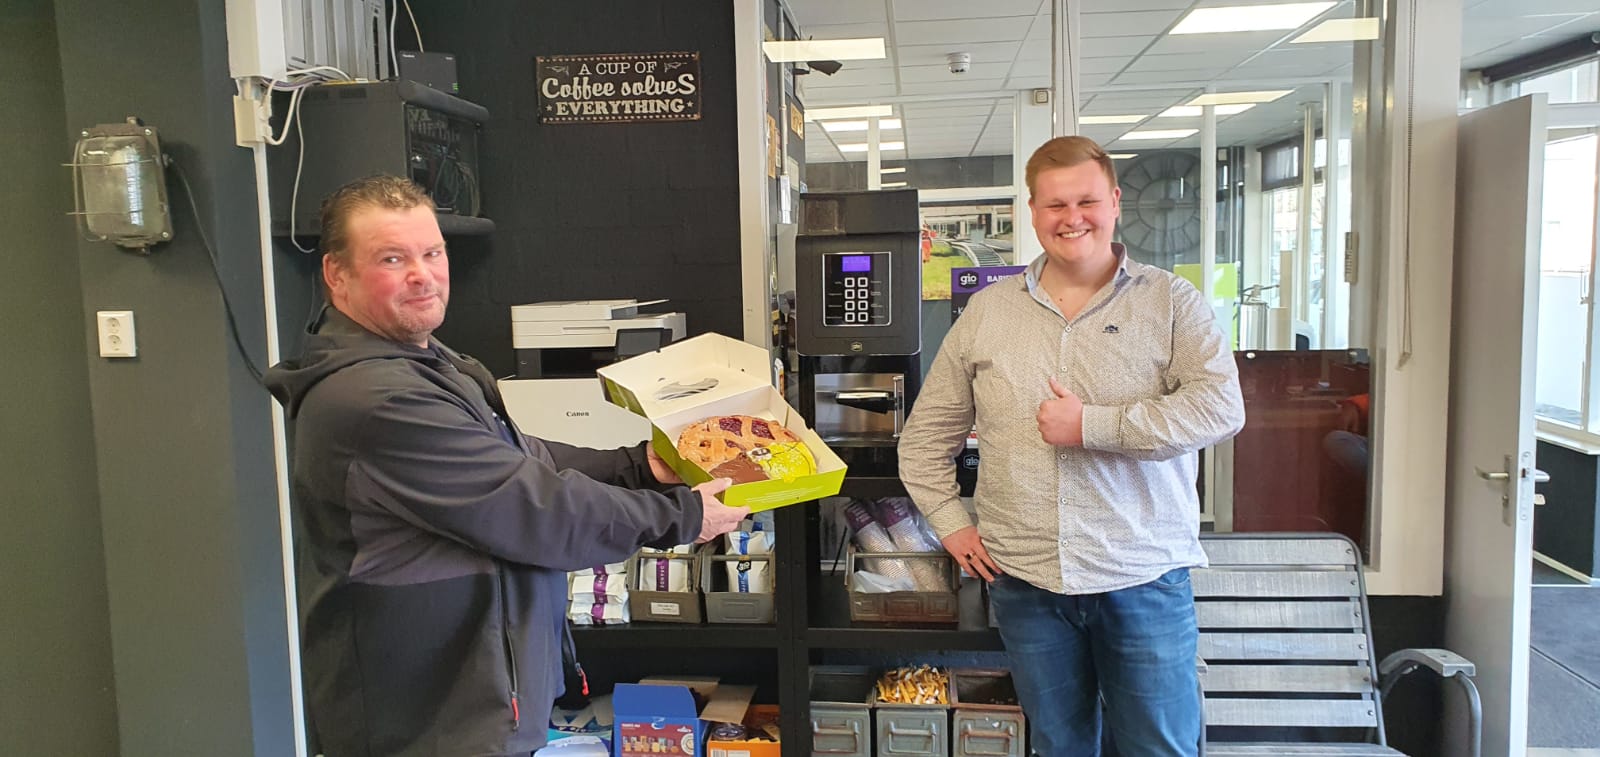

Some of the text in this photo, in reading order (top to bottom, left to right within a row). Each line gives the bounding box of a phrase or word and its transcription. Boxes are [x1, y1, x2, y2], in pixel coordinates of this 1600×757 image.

[578, 61, 658, 75] A CUP OF
[542, 76, 616, 101] Coffee
[555, 98, 686, 116] EVERYTHING
[960, 273, 977, 286] gio
